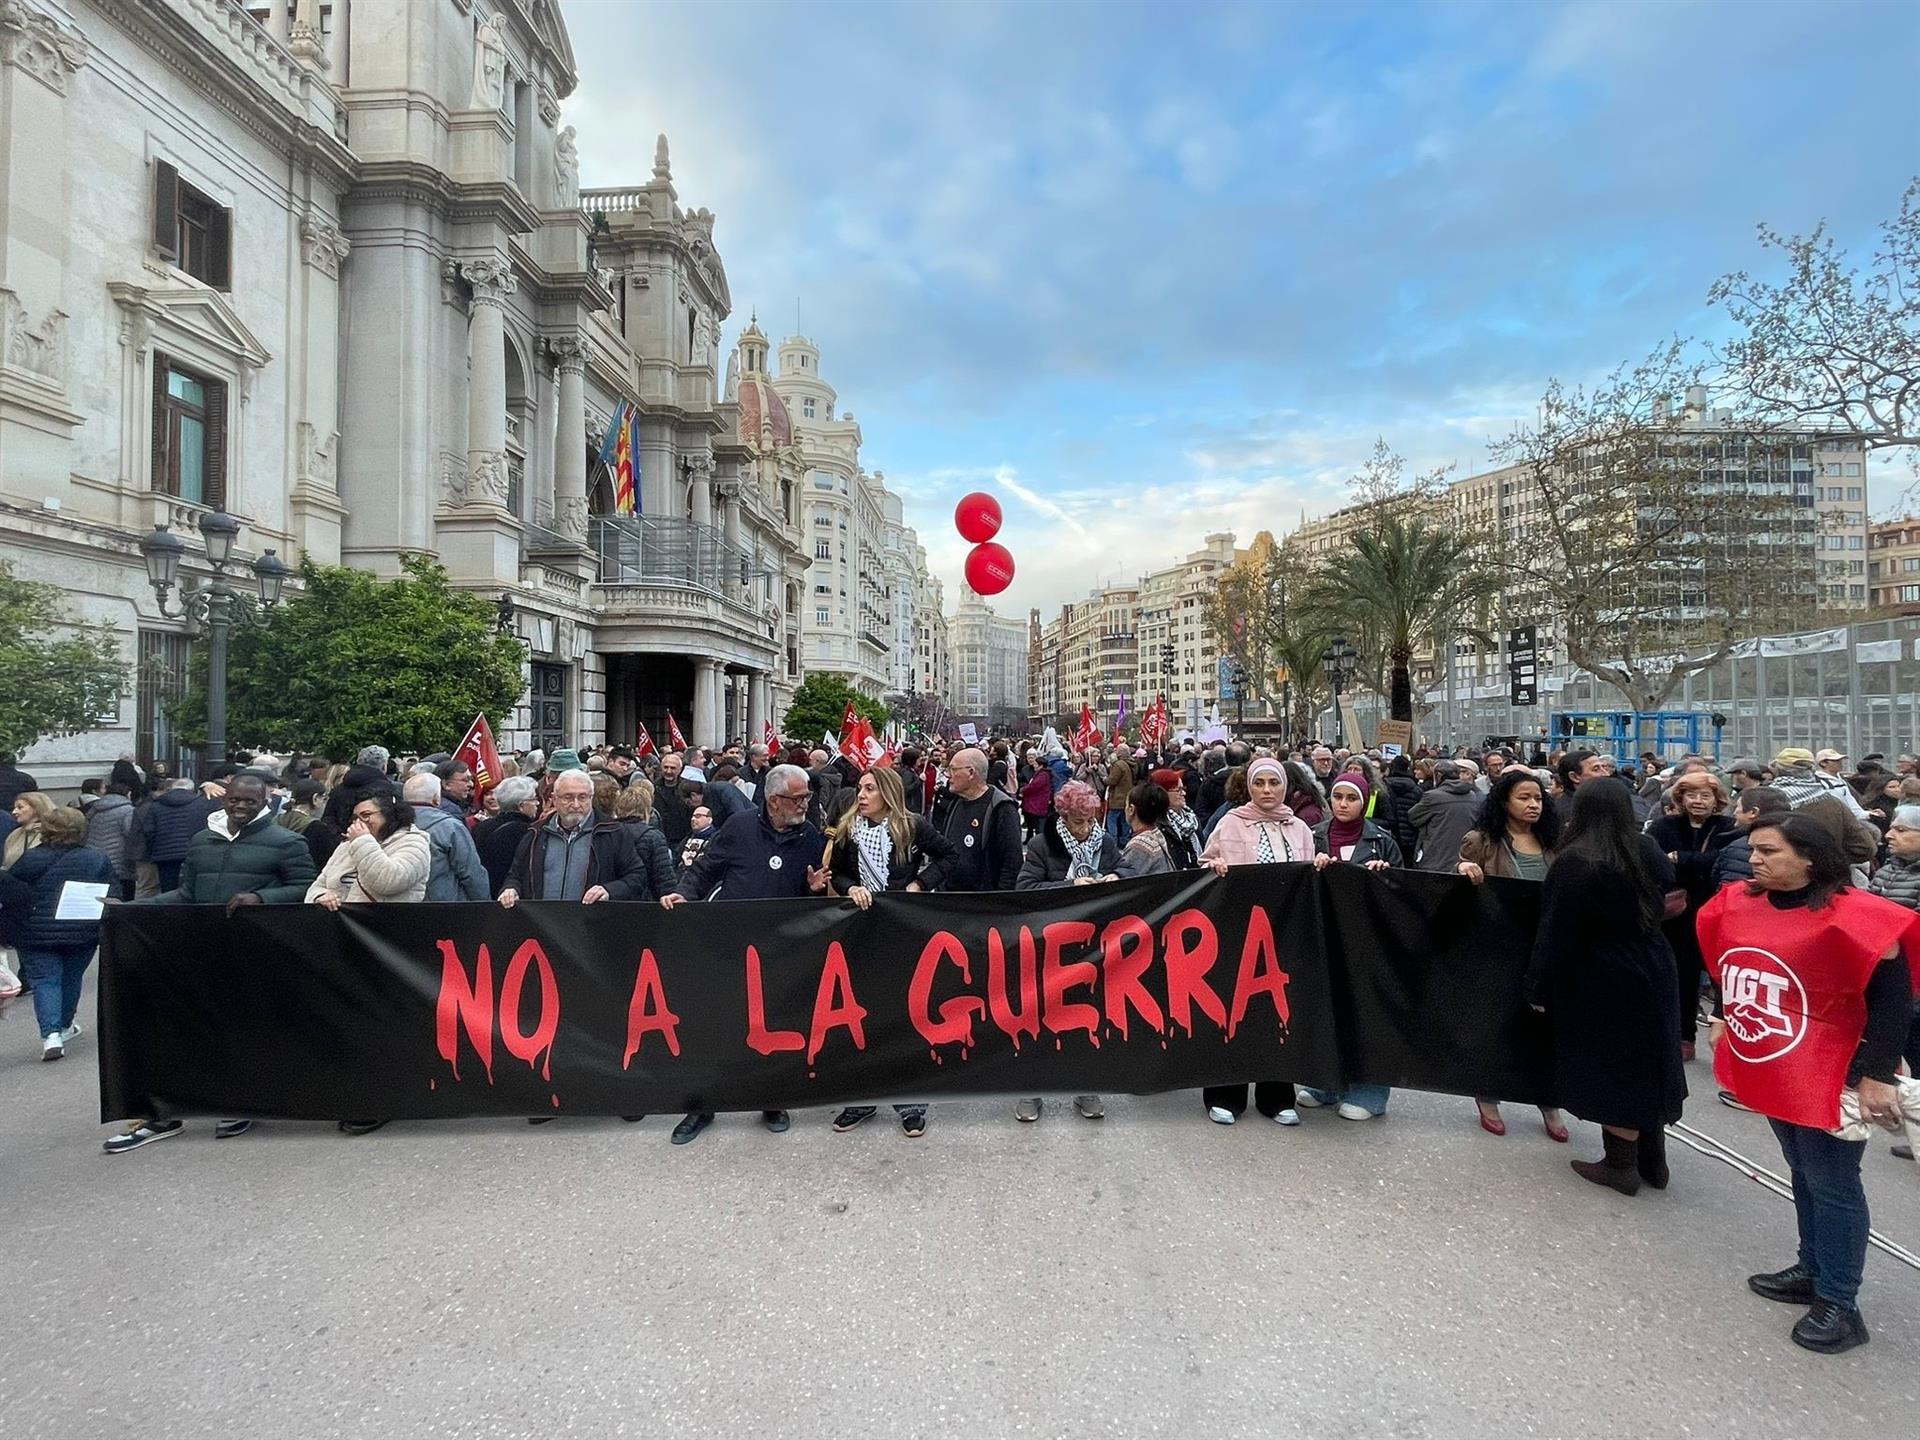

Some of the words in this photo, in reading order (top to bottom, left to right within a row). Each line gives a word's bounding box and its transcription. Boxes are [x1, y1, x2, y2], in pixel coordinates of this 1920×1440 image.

[436, 938, 560, 1086] NO
[622, 948, 680, 1071] A
[745, 941, 868, 1067] LA
[908, 905, 1290, 1057] GUERRA
[1721, 963, 1789, 1017] UGT
